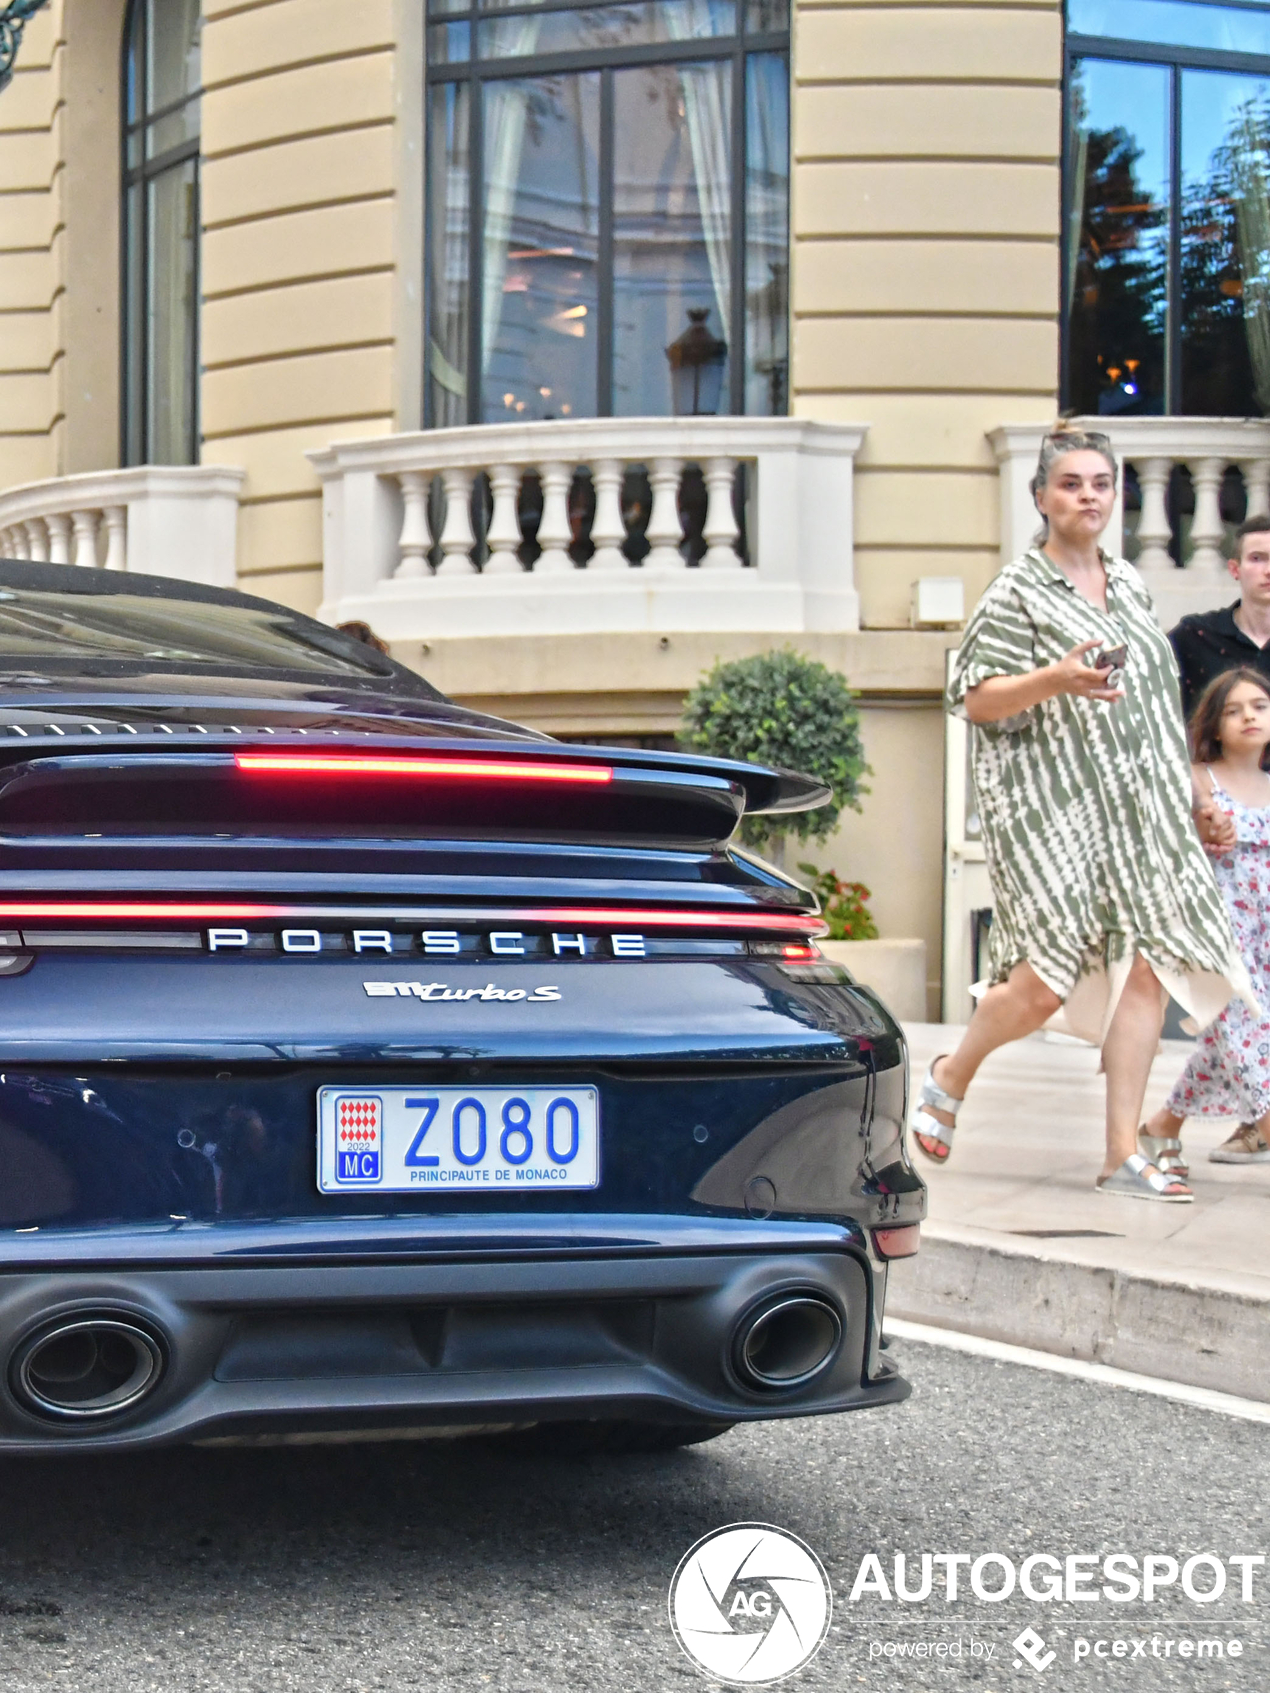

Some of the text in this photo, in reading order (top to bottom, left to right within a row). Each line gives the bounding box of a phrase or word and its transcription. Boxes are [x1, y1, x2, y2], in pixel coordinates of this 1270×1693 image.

[207, 928, 647, 957] PORSCHE
[527, 986, 562, 1001] S
[404, 1096, 580, 1167] Z080
[347, 1142, 370, 1152] 2022
[344, 1154, 374, 1177] MC
[410, 1168, 568, 1182] PRINCIPAUTE DE MONACO
